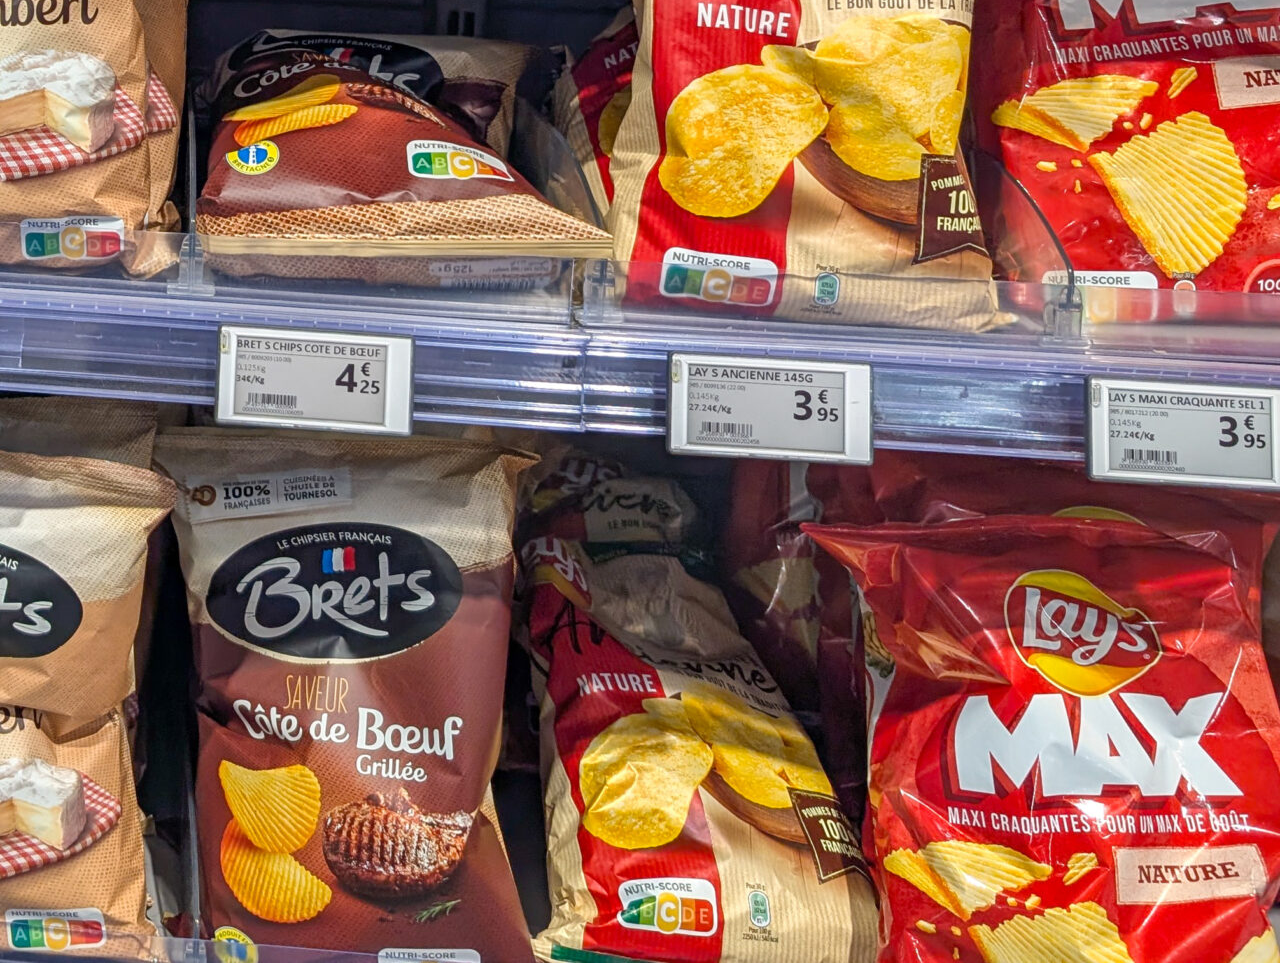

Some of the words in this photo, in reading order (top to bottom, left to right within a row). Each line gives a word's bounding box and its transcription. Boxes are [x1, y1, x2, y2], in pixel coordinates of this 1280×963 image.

[696, 2, 792, 38] NATURE
[1056, 47, 1089, 65] MAXI
[1094, 37, 1189, 62] CRAQUANTES
[1192, 29, 1232, 50] POUR
[1235, 27, 1254, 44] UN
[1259, 23, 1280, 42] MA
[233, 59, 315, 98] Côte
[414, 143, 484, 160] NUTRI-SCORE
[672, 252, 751, 270] NUTRI-SCORE
[237, 339, 260, 350] BRET
[265, 341, 271, 351] S
[273, 341, 302, 352] CHIPS
[304, 344, 328, 354] COTE
[331, 345, 346, 355] DE
[349, 347, 381, 358] BŒUF
[335, 363, 357, 393] 4
[360, 380, 380, 394] 25
[239, 551, 435, 638] Brets
[282, 675, 348, 713] SAVEUR
[576, 672, 656, 695] NATURE
[233, 699, 304, 742] Côte
[308, 712, 350, 744] de
[356, 707, 463, 761] Bœuf
[955, 691, 1244, 796] MAX
[355, 754, 428, 784] Grillée
[947, 806, 986, 829] MAXI
[991, 812, 1091, 835] CRAQUANTES
[1139, 815, 1153, 833] UN
[1156, 815, 1180, 833] MAX
[1186, 814, 1206, 832] DE
[1212, 808, 1250, 833] GOÛT
[1138, 860, 1239, 884] NATURE
[624, 882, 693, 895] NUTRI-SCORE
